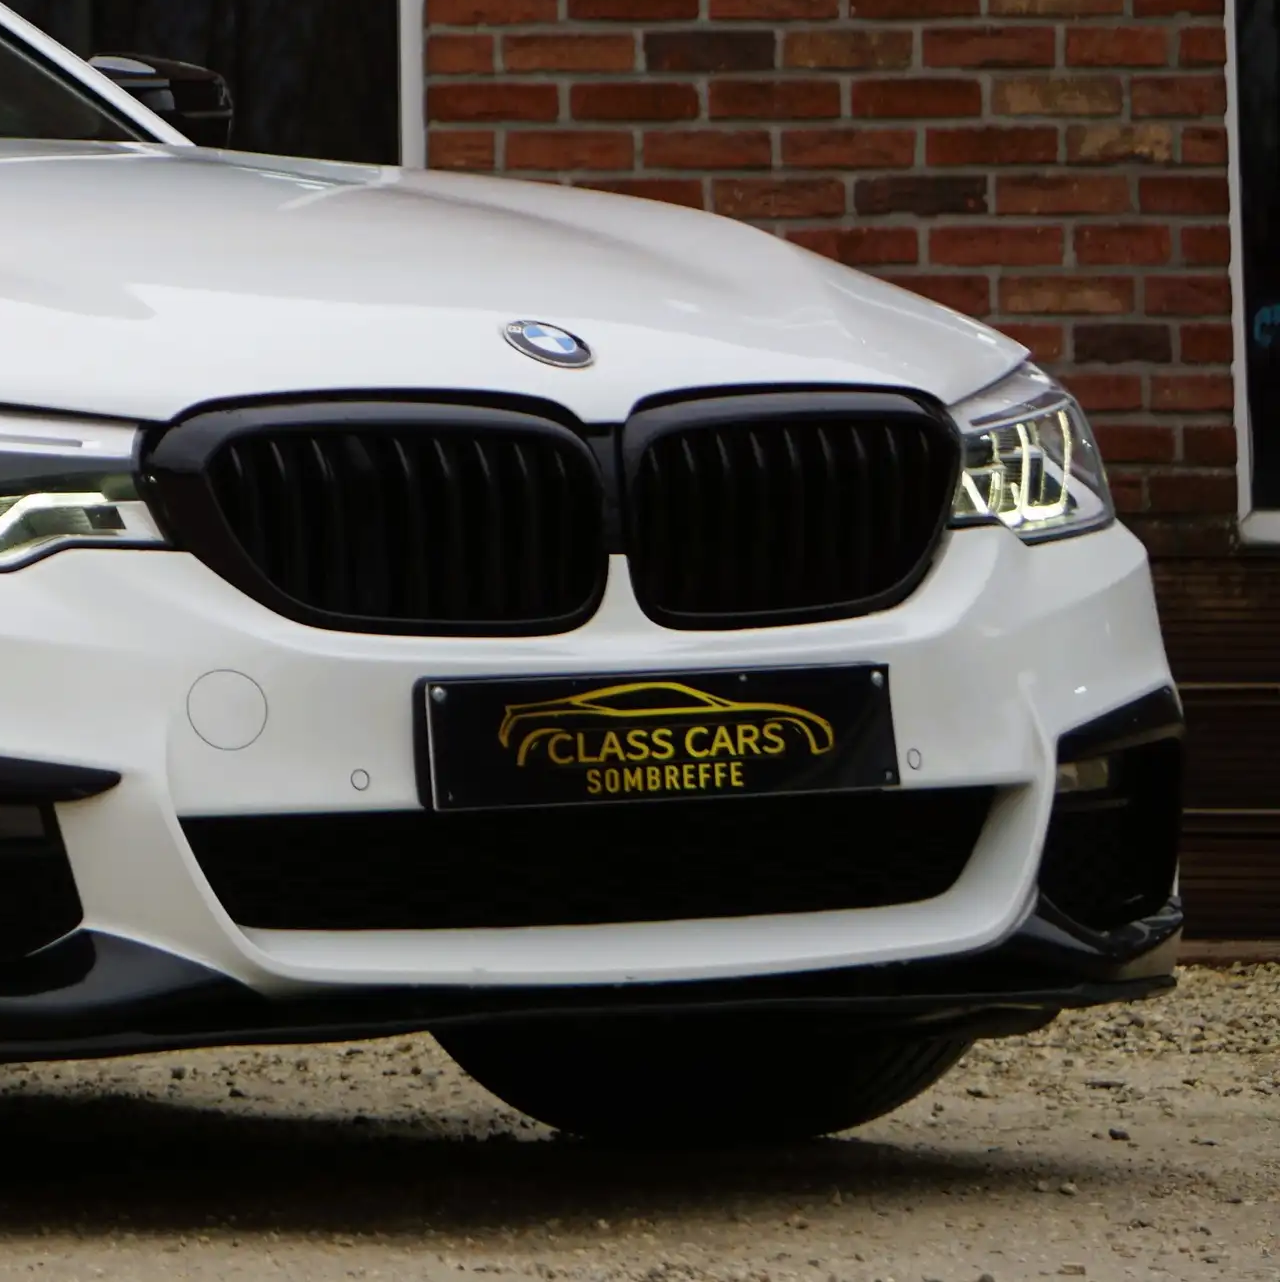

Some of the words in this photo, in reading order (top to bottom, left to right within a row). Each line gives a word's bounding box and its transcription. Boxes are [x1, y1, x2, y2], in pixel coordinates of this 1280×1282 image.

[547, 728, 676, 764] CLASS
[685, 723, 786, 757] CARS
[586, 761, 745, 795] SOMBREFFE
